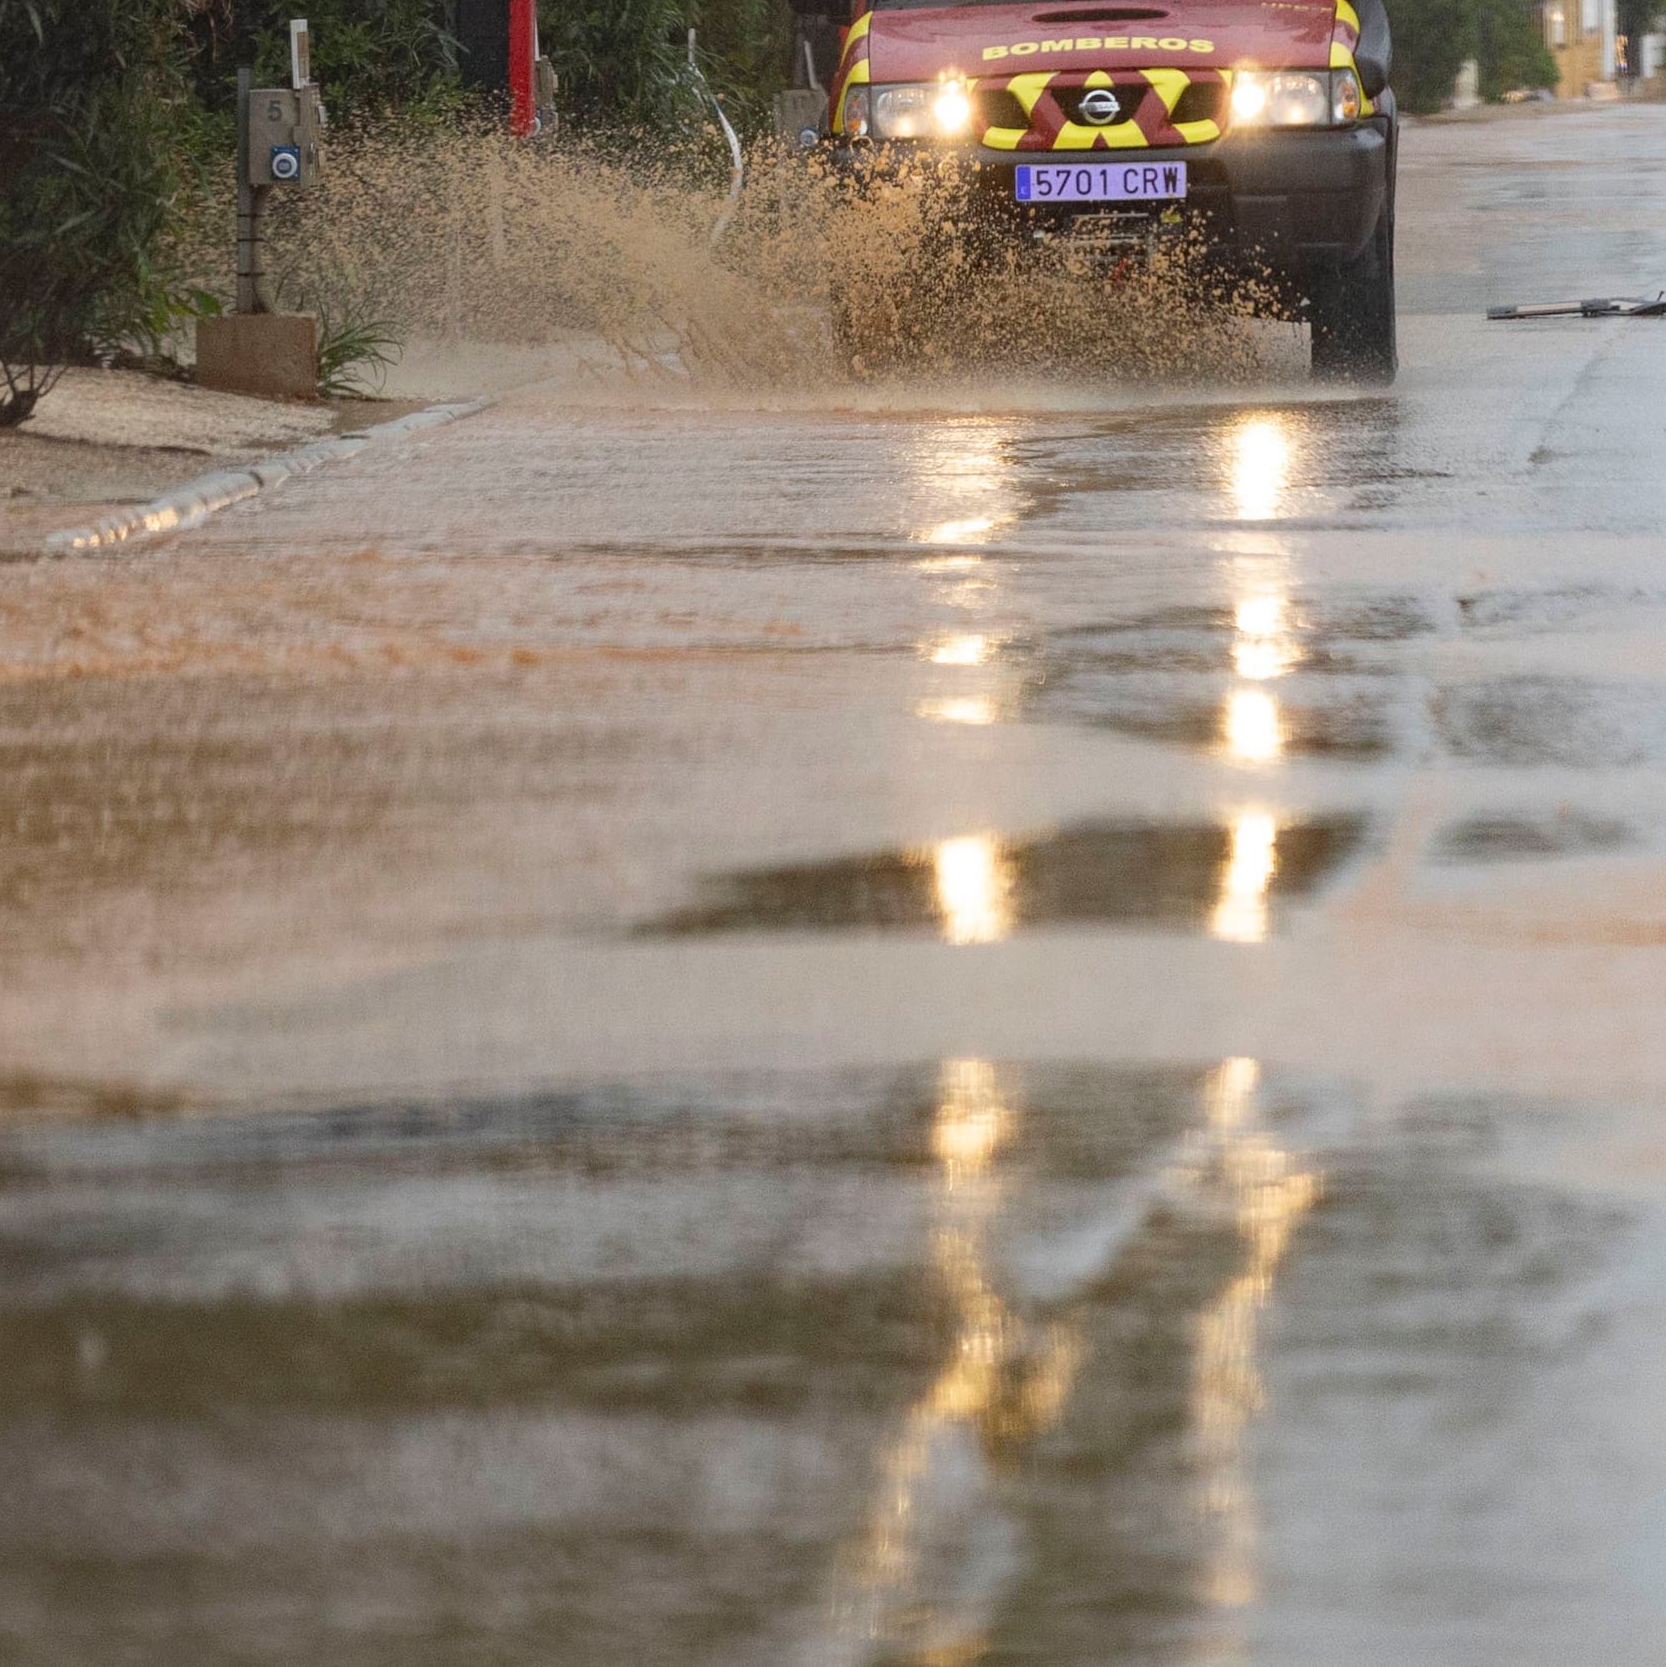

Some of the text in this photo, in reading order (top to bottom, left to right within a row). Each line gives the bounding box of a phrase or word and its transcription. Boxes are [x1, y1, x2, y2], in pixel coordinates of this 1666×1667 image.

[983, 37, 1215, 61] BOMBEROS
[267, 99, 283, 122] 5
[1036, 167, 1178, 196] 5701 CRW
